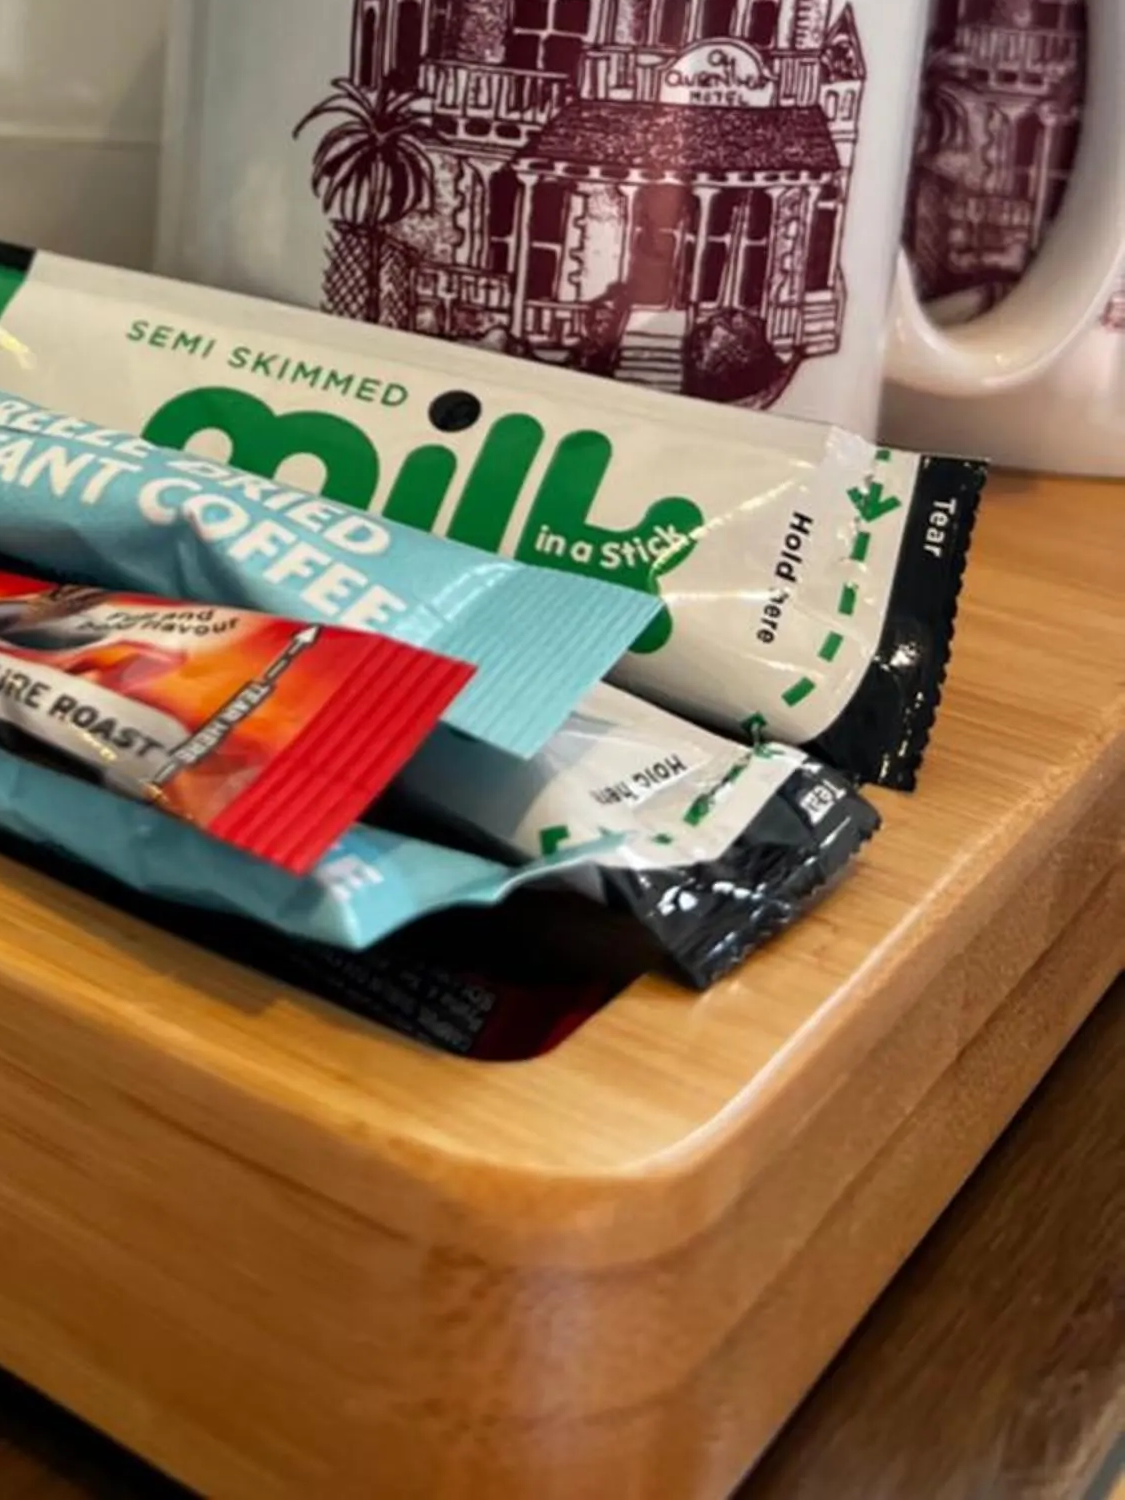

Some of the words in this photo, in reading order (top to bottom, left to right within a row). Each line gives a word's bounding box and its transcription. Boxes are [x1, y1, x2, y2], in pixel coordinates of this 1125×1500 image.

[126, 320, 214, 359] SEMI
[227, 347, 409, 408] SKIMMED
[138, 477, 408, 631] COFFEE
[141, 386, 704, 654] milk
[534, 523, 567, 557] in
[569, 540, 594, 563] a
[598, 523, 690, 571] Stick
[774, 510, 814, 583] Hold
[922, 497, 958, 559] Tear
[755, 586, 791, 645] here
[47, 693, 164, 762] ROAST
